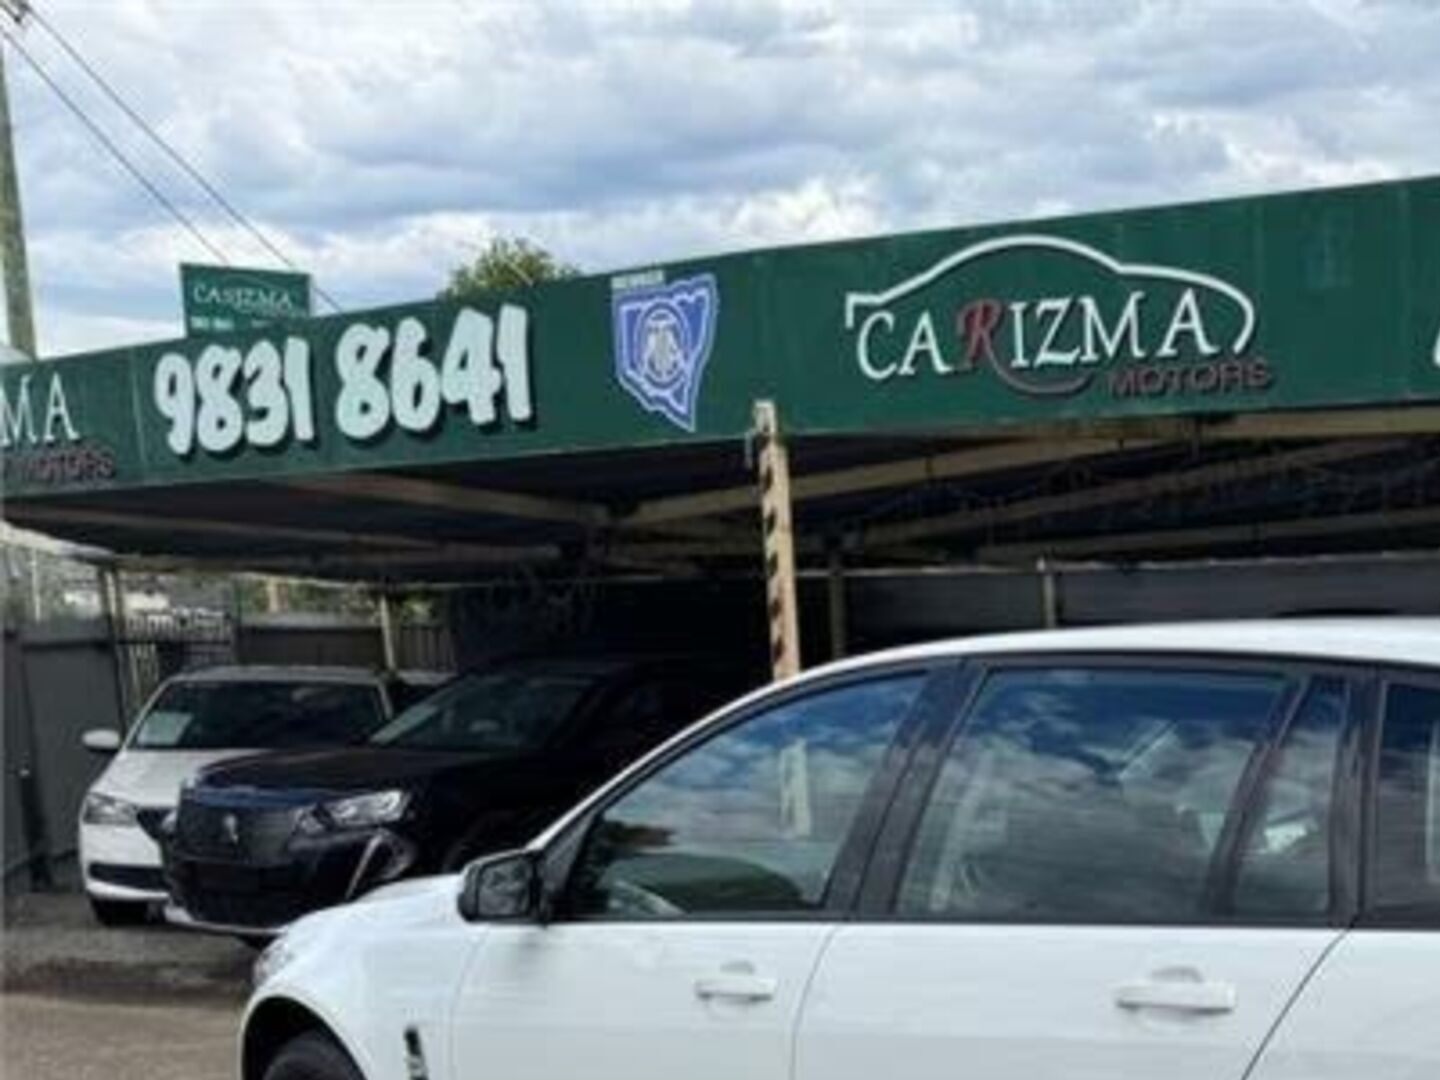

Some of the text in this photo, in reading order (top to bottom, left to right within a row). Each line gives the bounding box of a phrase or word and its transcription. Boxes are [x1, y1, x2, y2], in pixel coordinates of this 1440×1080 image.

[857, 289, 1219, 379] CARIZMA
[1107, 357, 1271, 397] MOTORS
[154, 305, 533, 455] 9831 8641
